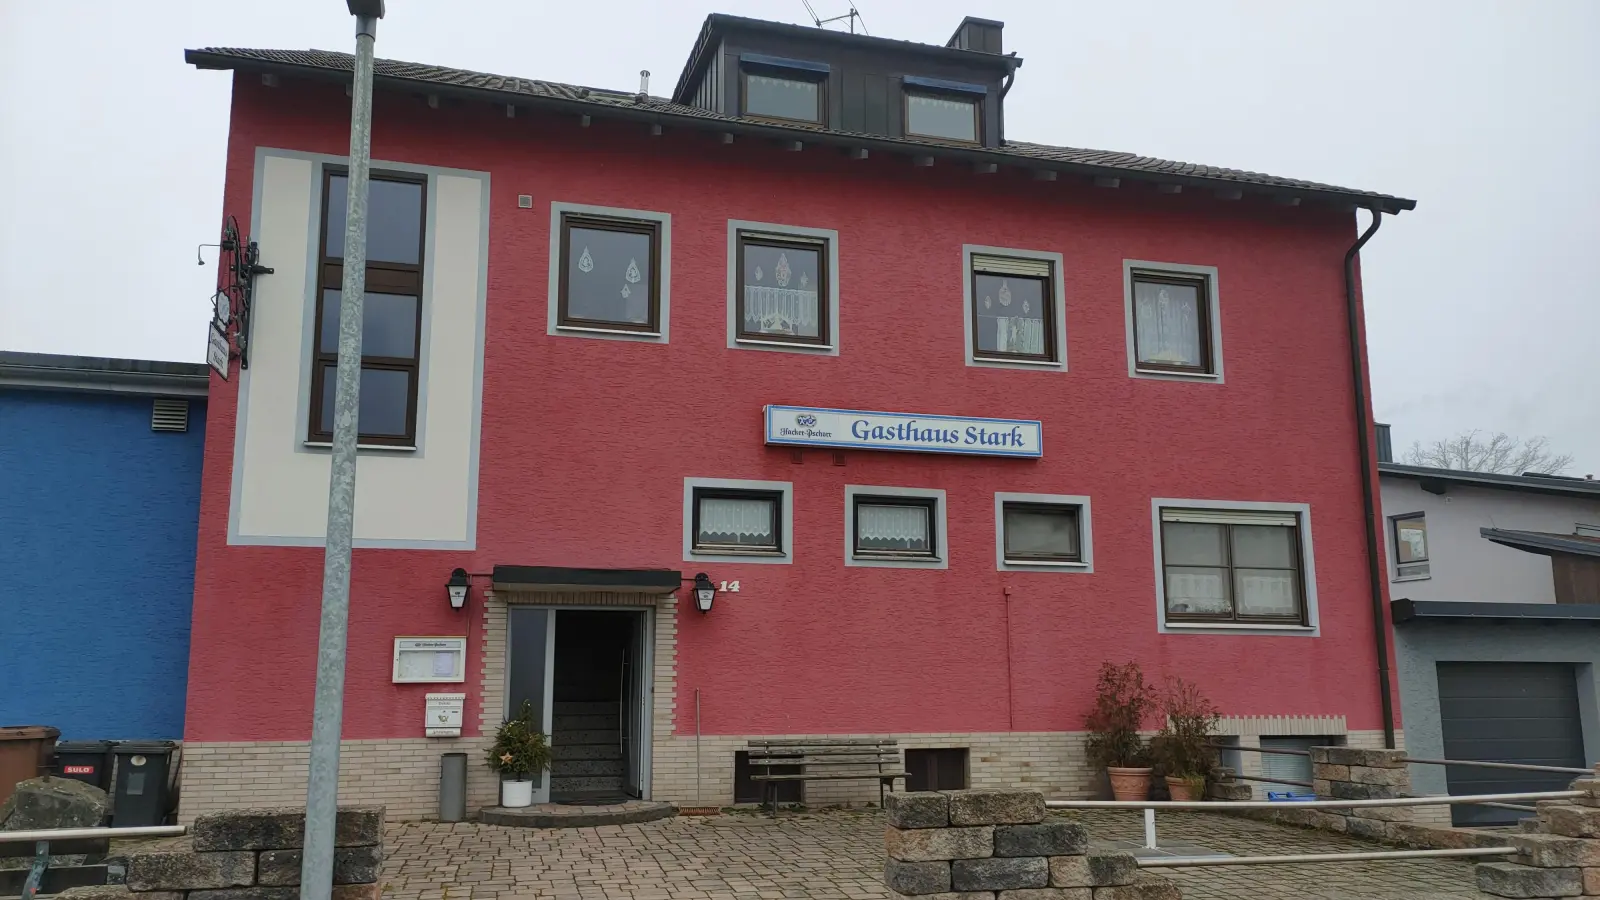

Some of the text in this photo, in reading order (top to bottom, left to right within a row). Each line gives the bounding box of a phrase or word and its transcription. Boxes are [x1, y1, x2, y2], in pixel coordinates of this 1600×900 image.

[851, 419, 1026, 447] Gasthaus Stark
[718, 580, 740, 592] 14
